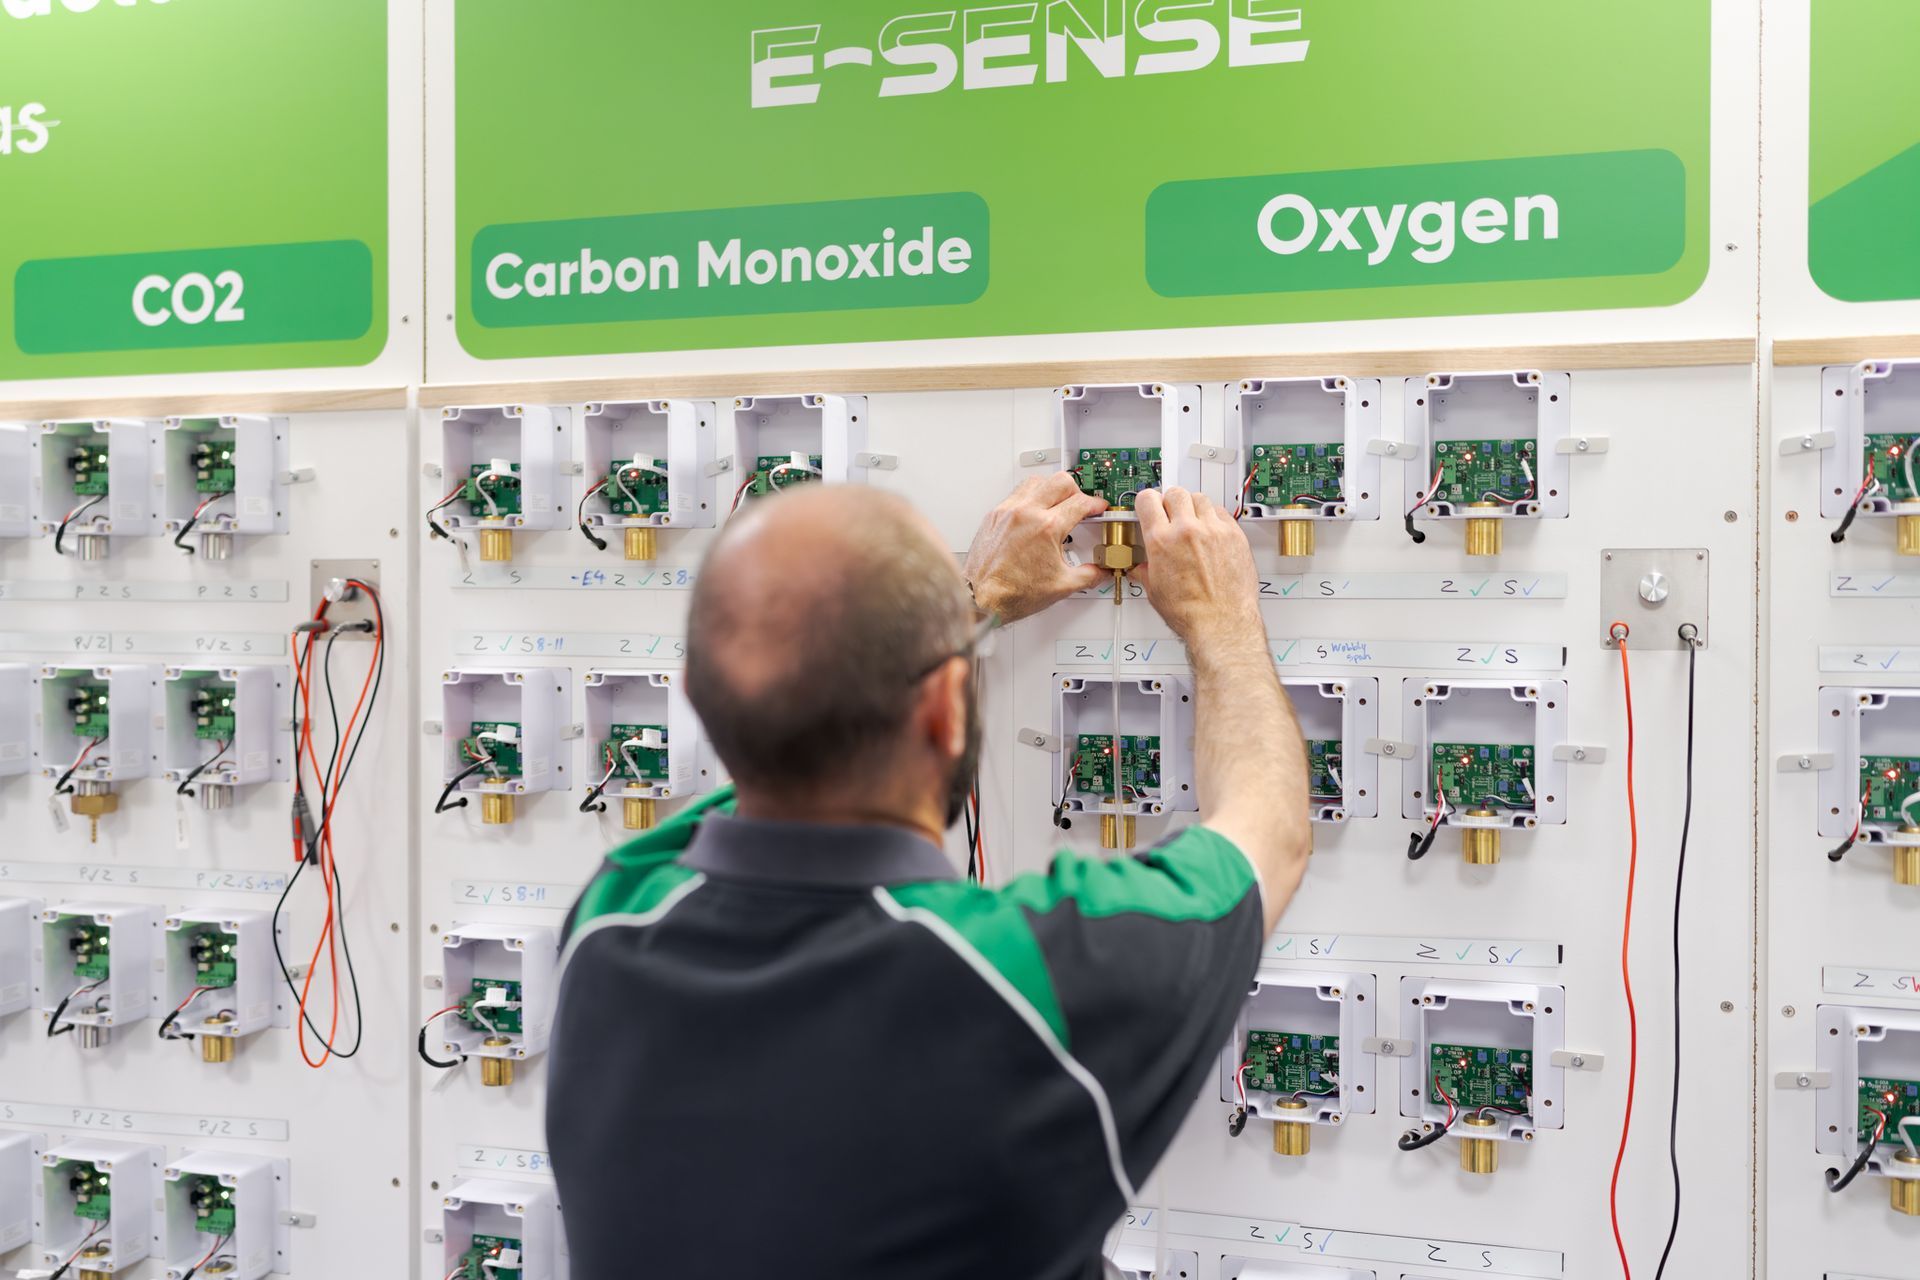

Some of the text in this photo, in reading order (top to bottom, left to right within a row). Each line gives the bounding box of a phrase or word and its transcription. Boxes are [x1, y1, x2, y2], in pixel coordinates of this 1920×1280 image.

[750, 0, 1311, 108] E-SENSE
[1257, 193, 1559, 266] Oxygen
[485, 226, 973, 300] Carbon Monoxide
[131, 270, 246, 327] CO2
[510, 571, 522, 584] S
[1319, 581, 1335, 596] S
[1503, 579, 1518, 595] S
[674, 642, 685, 658] S
[1124, 643, 1137, 661] S
[1505, 649, 1519, 664] S
[1309, 938, 1320, 955] S
[1488, 946, 1500, 964] S
[1303, 1232, 1313, 1250] S
[1481, 1251, 1493, 1269] S
